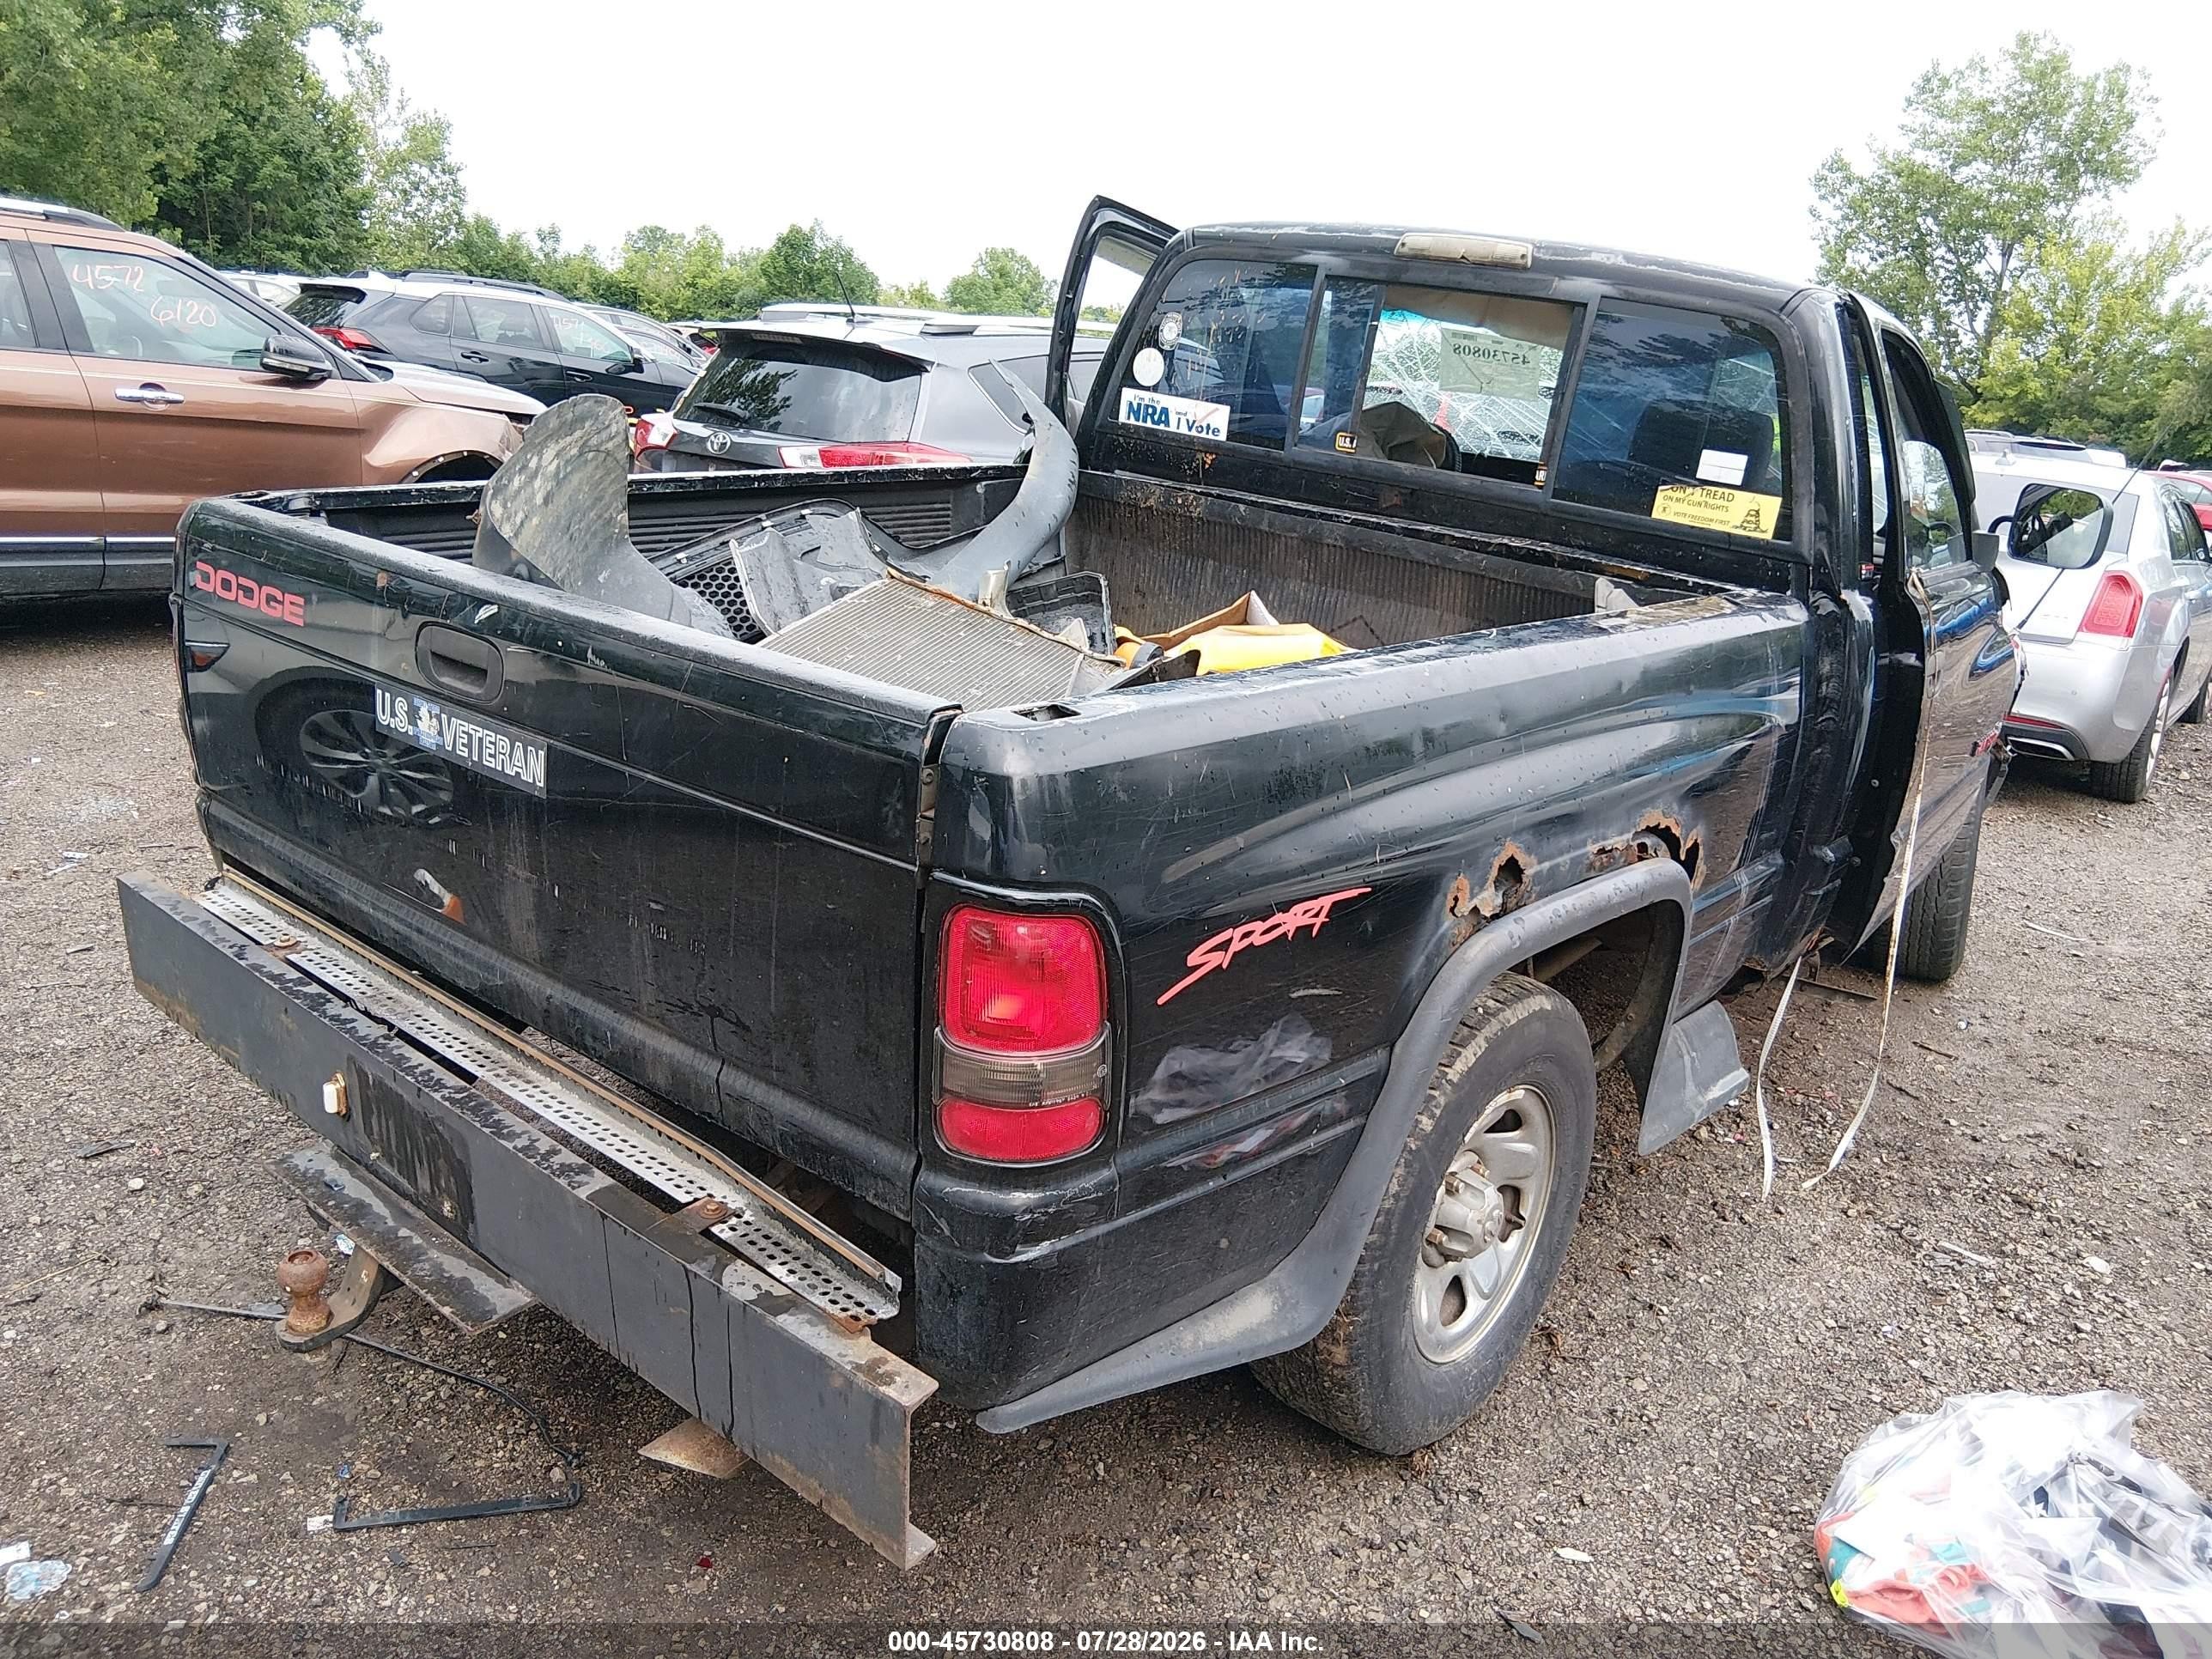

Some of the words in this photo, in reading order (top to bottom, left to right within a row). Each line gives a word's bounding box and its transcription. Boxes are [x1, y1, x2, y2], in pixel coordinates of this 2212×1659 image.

[72, 264, 145, 293] 4572
[149, 295, 216, 327] 6120
[1133, 394, 1145, 403] I'm
[1148, 397, 1161, 405] the
[1126, 400, 1170, 428] NRA
[1176, 418, 1182, 430] I
[1186, 418, 1220, 437] Vote
[1662, 494, 1674, 502] ON
[1674, 496, 1686, 505] MY
[1686, 499, 1703, 508] GUN
[1703, 500, 1730, 513] RIGHTS
[1700, 487, 1735, 503] TREAD
[1673, 511, 1688, 520] VOTE
[1688, 513, 1715, 524] FREEDOM
[1714, 518, 1731, 526] FIRST
[195, 560, 306, 628] DODGE
[375, 688, 414, 736] U.S.
[441, 713, 545, 788] VETERAN
[1157, 886, 1372, 1006] SPORT
